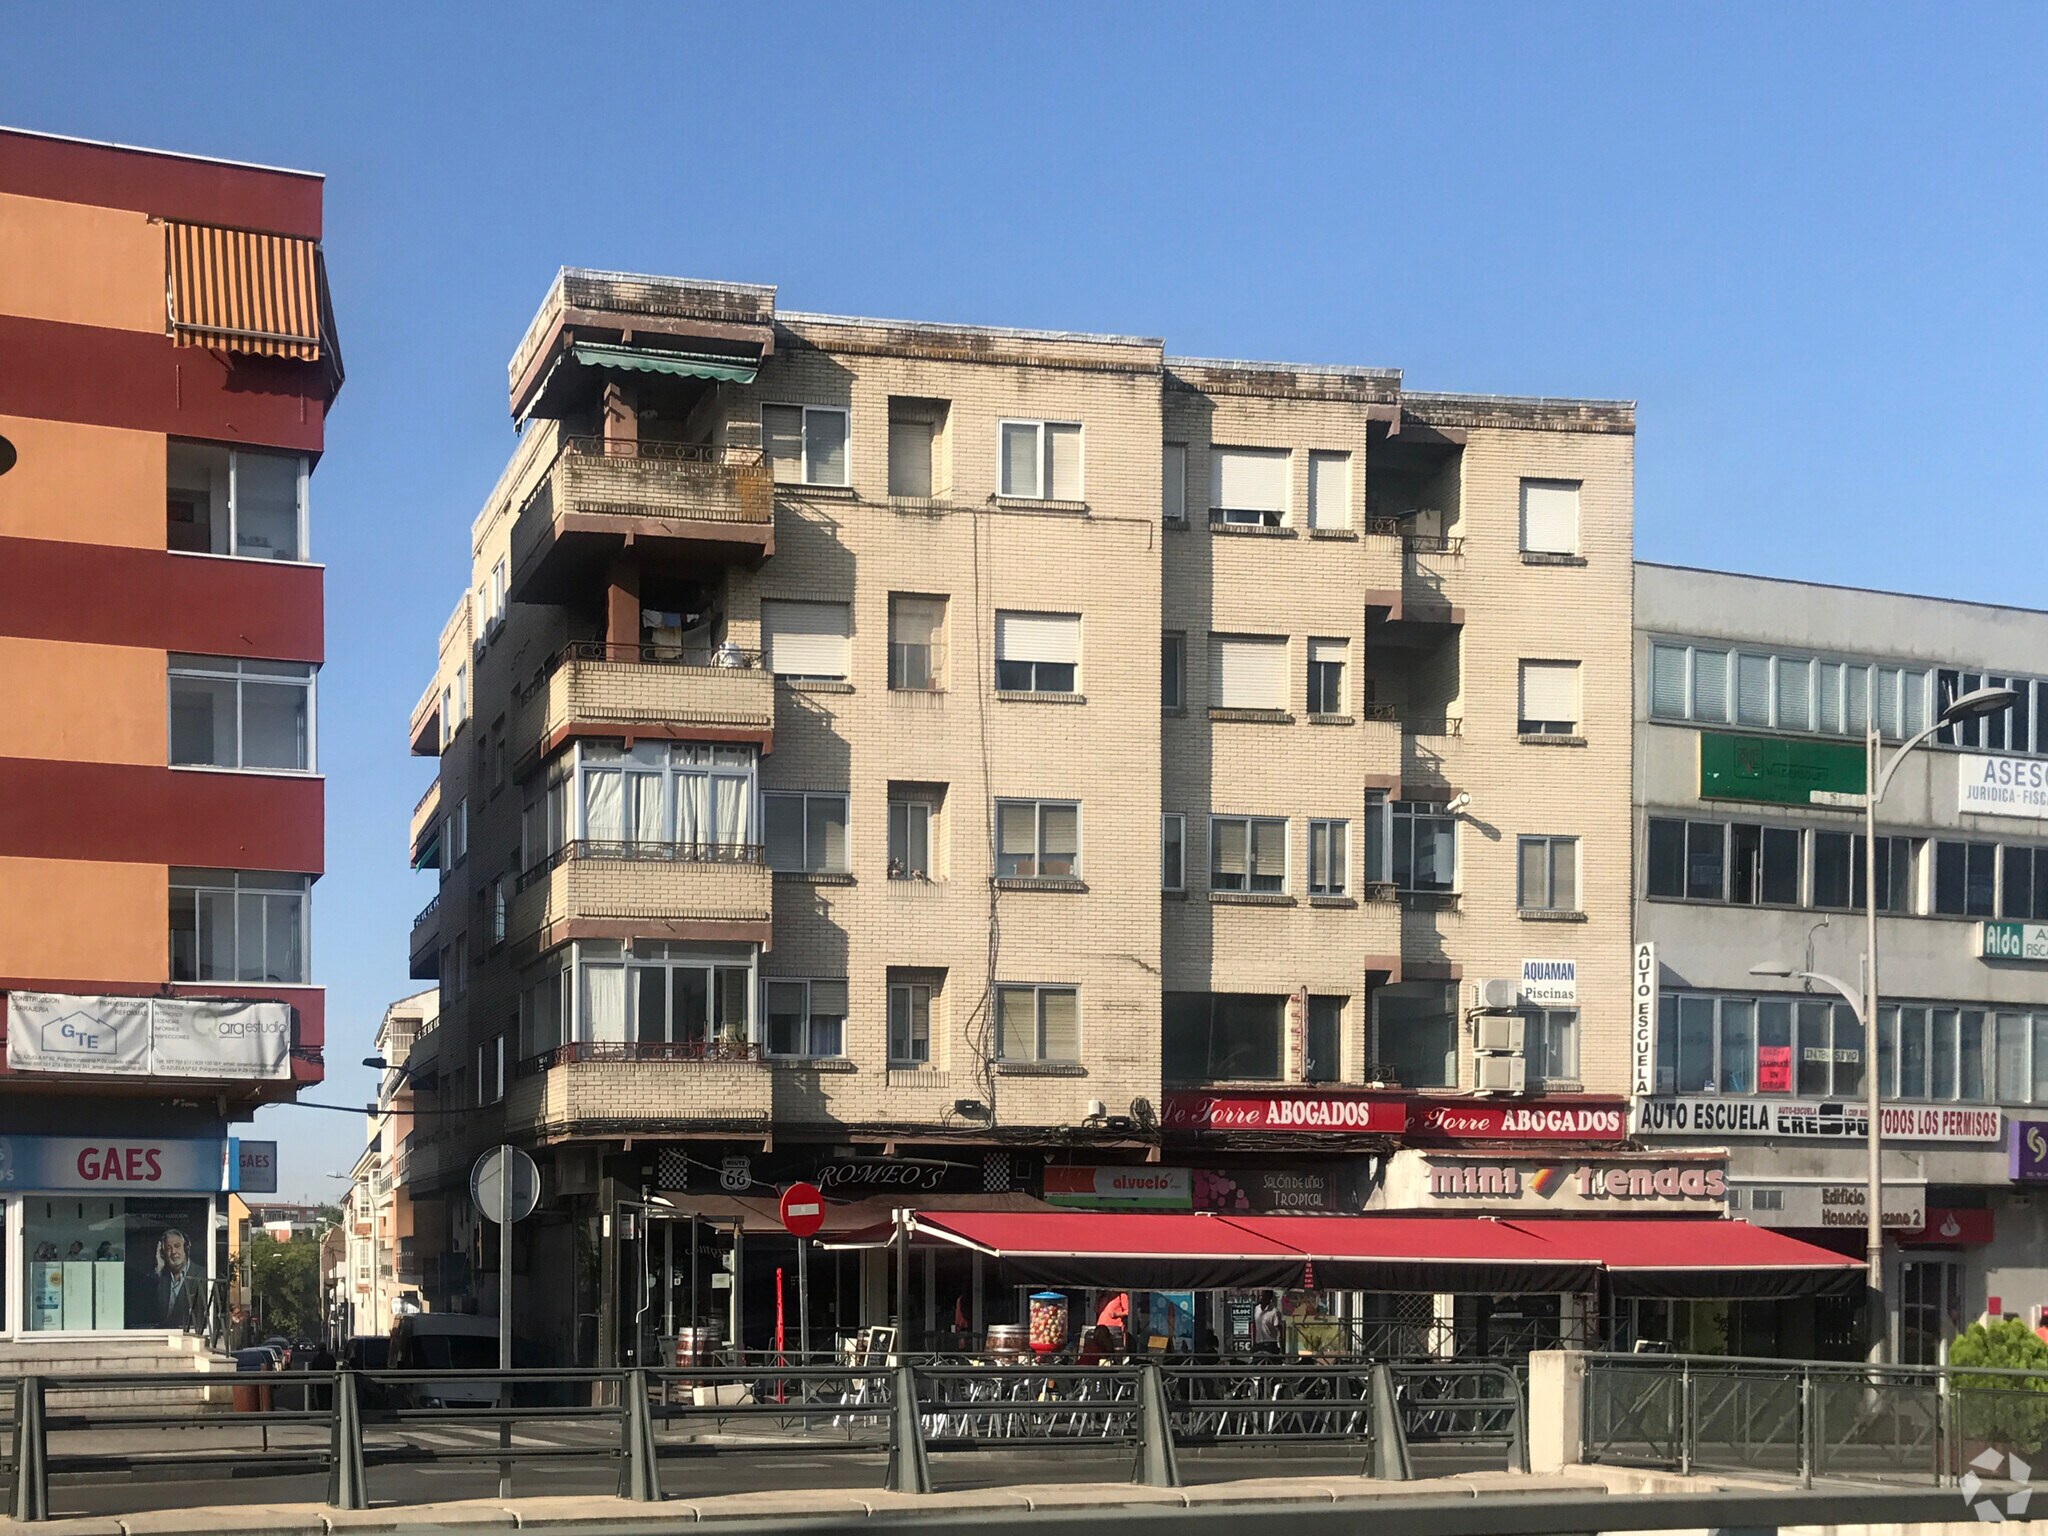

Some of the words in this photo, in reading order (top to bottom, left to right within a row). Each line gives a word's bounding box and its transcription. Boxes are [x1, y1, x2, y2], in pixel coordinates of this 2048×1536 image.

[1984, 759, 2048, 789] ASES
[1967, 785, 2048, 806] JURIDICA-FISC
[1986, 925, 2020, 955] Alda
[2035, 929, 2048, 941] A
[1523, 962, 1575, 983] AQUAMAN
[1638, 945, 1650, 997] AUTO
[1525, 987, 1574, 999] Piscinas
[61, 1024, 99, 1049] GTE
[1636, 1002, 1650, 1093] ESCUELA
[1163, 1097, 1186, 1123] De
[1192, 1098, 1260, 1124] Torre
[1266, 1100, 1369, 1126] ABOGADOS
[1423, 1107, 1491, 1131] Torre
[1501, 1109, 1620, 1132] ABOGADOS
[1641, 1103, 1687, 1129] AUTO
[1694, 1104, 1770, 1130] ESCUELA
[1918, 1110, 1938, 1136] LOS
[1942, 1111, 1997, 1137] PERMISOS
[77, 1147, 162, 1181] GAES
[239, 1154, 270, 1168] GAES
[725, 1170, 746, 1186] 66
[1429, 1166, 1519, 1195] mini
[1574, 1166, 1727, 1196] tiendas
[1273, 1190, 1324, 1207] TROPICAL
[1822, 1187, 1866, 1205] Edificio
[1822, 1209, 1869, 1226] Honorio
[1913, 1209, 1921, 1226] 2
[1233, 1341, 1251, 1351] 15€
